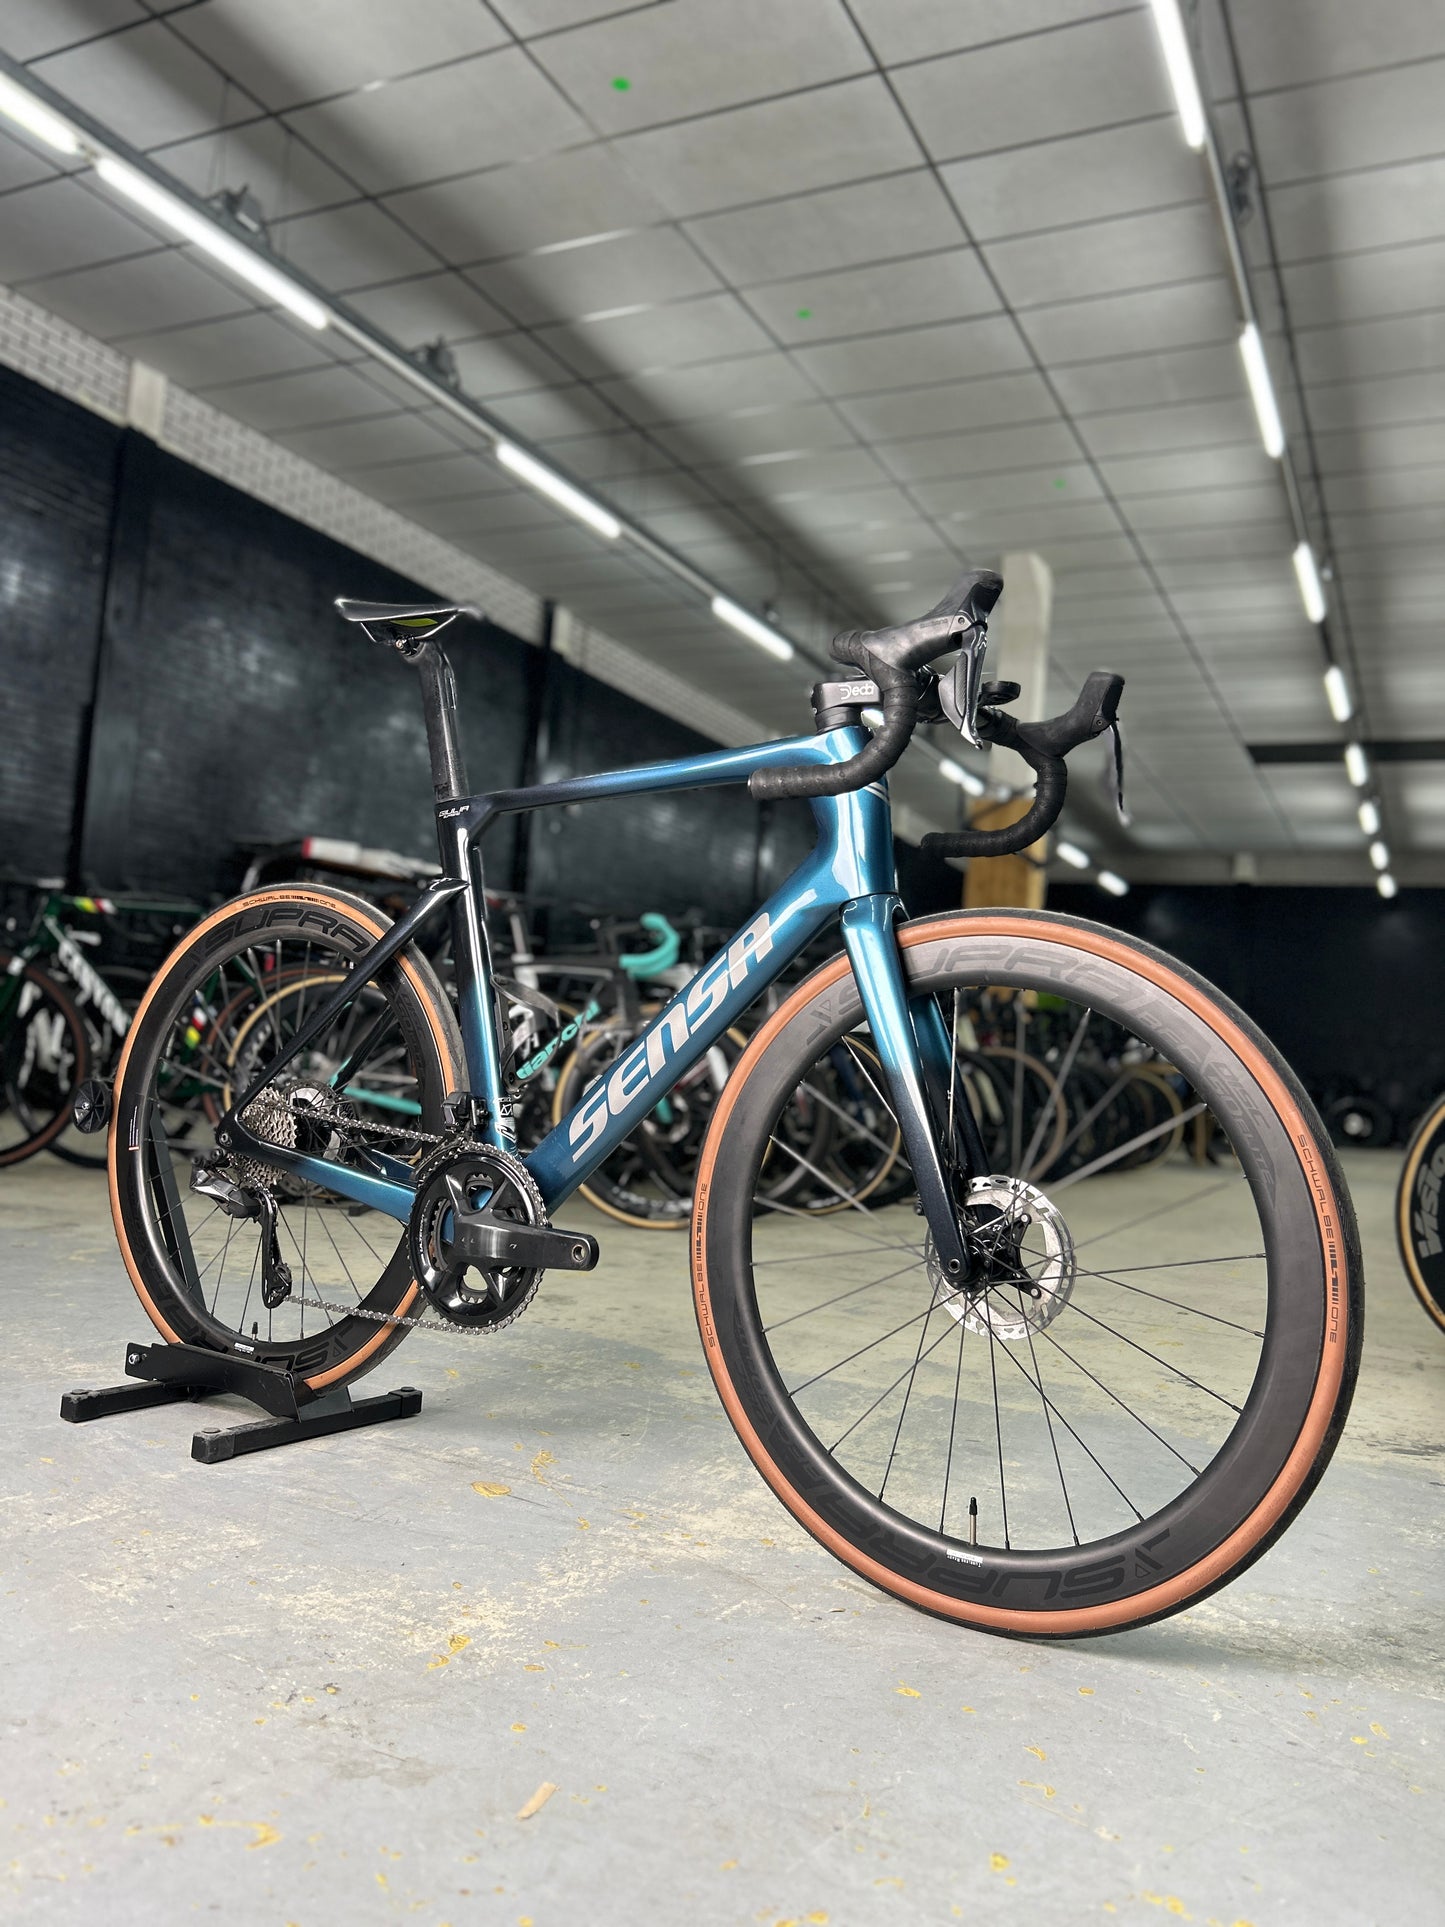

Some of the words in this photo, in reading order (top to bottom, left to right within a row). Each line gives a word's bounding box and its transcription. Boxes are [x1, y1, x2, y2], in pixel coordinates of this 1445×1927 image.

[205, 907, 371, 953] SUPRA
[242, 895, 290, 907] SCHWALBE
[319, 900, 337, 909] ONE
[569, 912, 774, 1163] SENSA
[698, 1182, 708, 1212] ONE
[1297, 1134, 1335, 1239] SCHWALBE
[1328, 1306, 1340, 1344] ONE
[696, 1263, 716, 1348] SCHWALBE
[816, 1493, 1126, 1601] SUPRA
